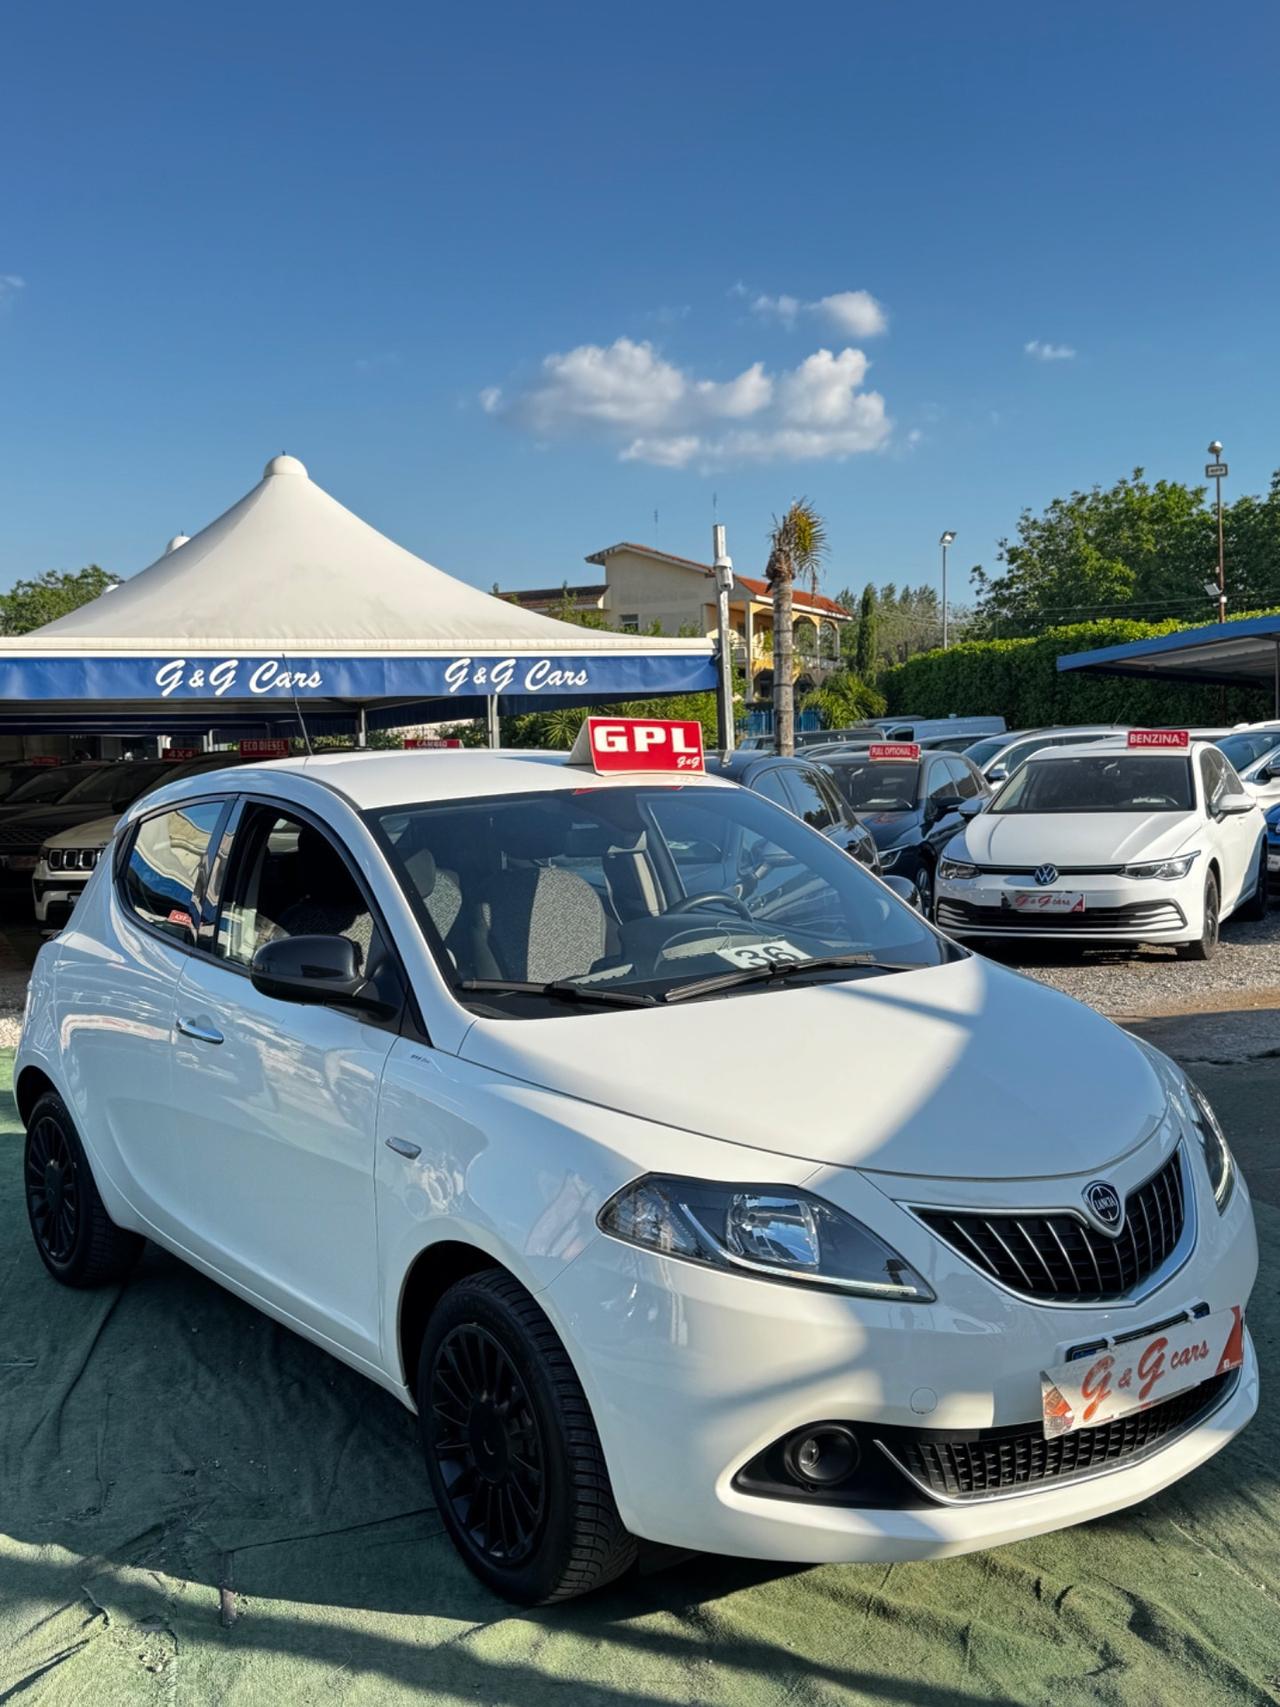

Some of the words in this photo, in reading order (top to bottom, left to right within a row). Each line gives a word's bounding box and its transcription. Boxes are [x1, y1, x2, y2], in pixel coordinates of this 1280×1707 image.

[249, 660, 323, 693] Cars
[524, 660, 588, 691] Cars
[259, 740, 285, 751] DIESEL
[593, 726, 699, 753] GPL
[1130, 733, 1180, 744] BENZINA
[735, 946, 801, 966] 36
[1170, 1340, 1209, 1369] cars
